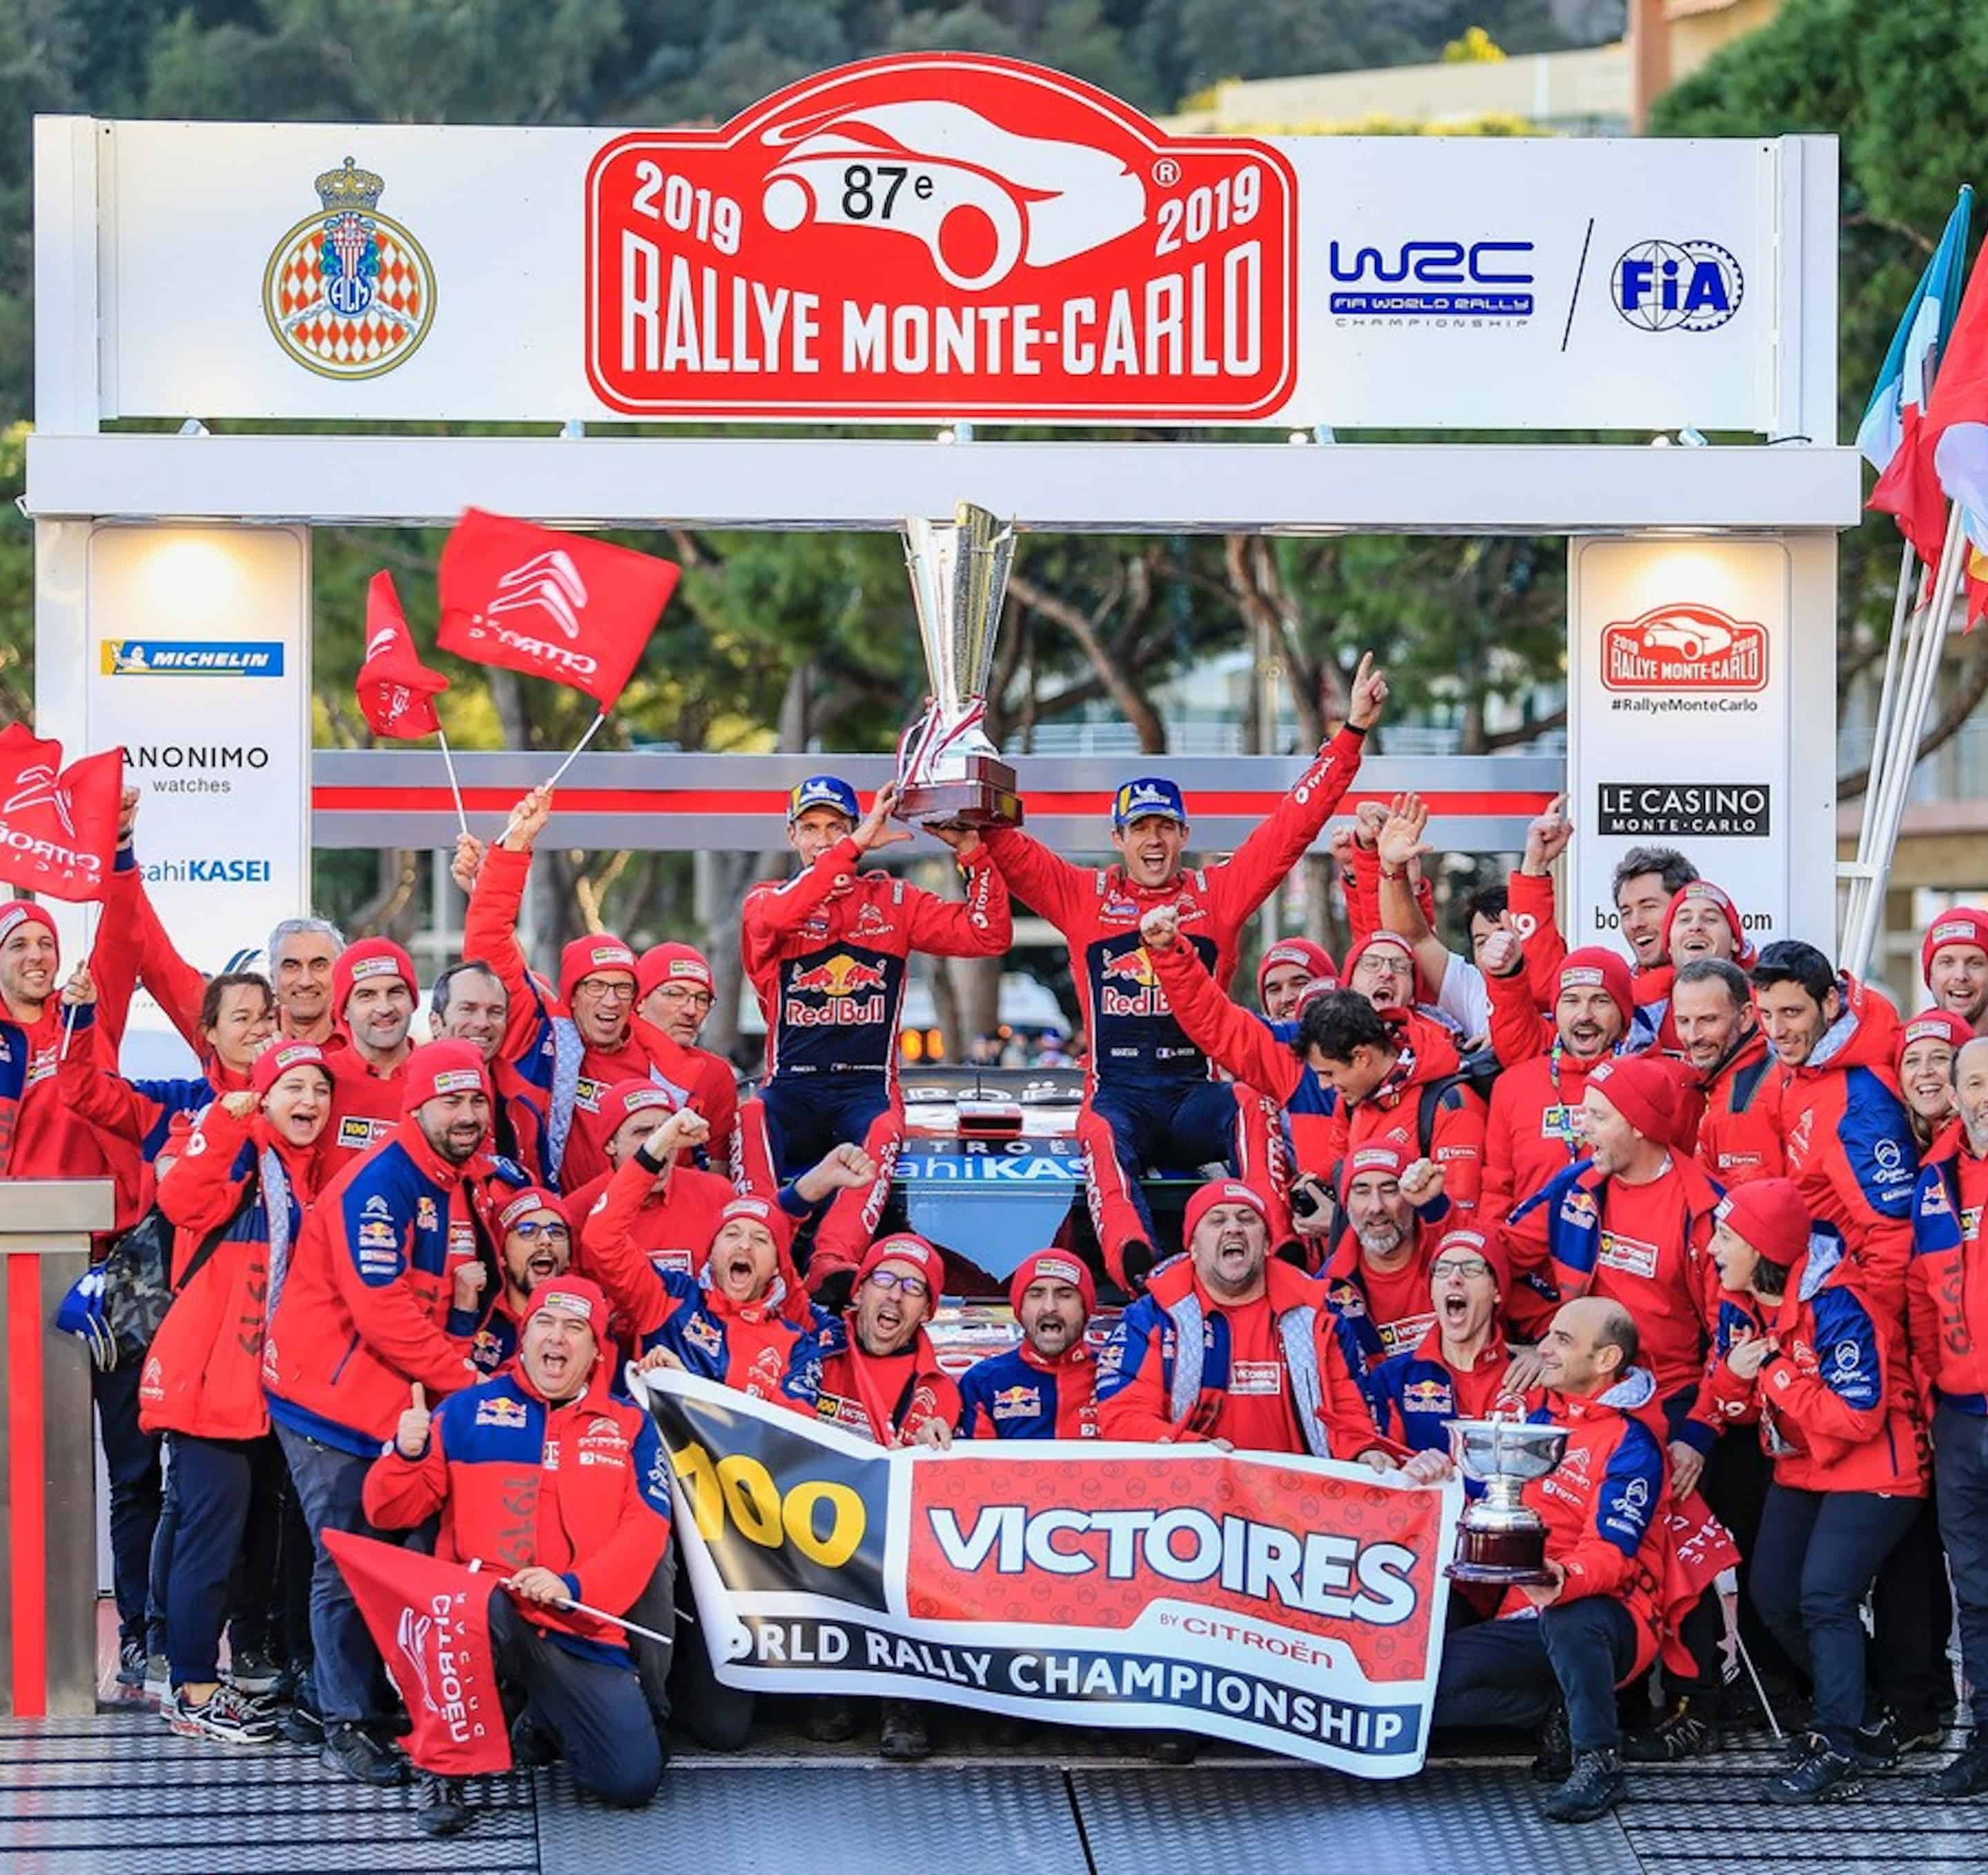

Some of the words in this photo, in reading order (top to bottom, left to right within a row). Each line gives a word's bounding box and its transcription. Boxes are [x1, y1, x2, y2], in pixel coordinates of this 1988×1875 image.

[632, 159, 742, 255] 2019
[1155, 165, 1261, 257] 2019
[1330, 241, 1534, 283] WRC
[622, 228, 819, 373] RALLYE
[843, 240, 1261, 377] MONTE-CARLO
[1371, 297, 1449, 309] WORLD
[1454, 297, 1530, 310] RALLY
[1335, 317, 1528, 328] CHAMPIONSHIP
[152, 652, 269, 667] MICHELIN
[1612, 646, 1657, 679] RALLYE
[1661, 648, 1759, 680] MONTE-CARLO
[1611, 698, 1758, 714] #RallyeMonteCarlo
[153, 778, 231, 792] watches
[1603, 789, 1632, 813] LE
[1640, 787, 1765, 815] CASINO
[139, 860, 269, 882] sahiKASEI
[786, 997, 836, 1027] Red
[837, 996, 885, 1025] Bull
[1101, 986, 1151, 1017] Red
[902, 1140, 1069, 1154] ITROË
[671, 1441, 866, 1569] 100
[926, 1505, 1417, 1625] VICTOIRES
[1160, 1613, 1179, 1627] BY
[729, 1623, 850, 1662] ORLD
[865, 1631, 993, 1687] RALLY
[1010, 1656, 1402, 1751] CHAMPIONSHIP
